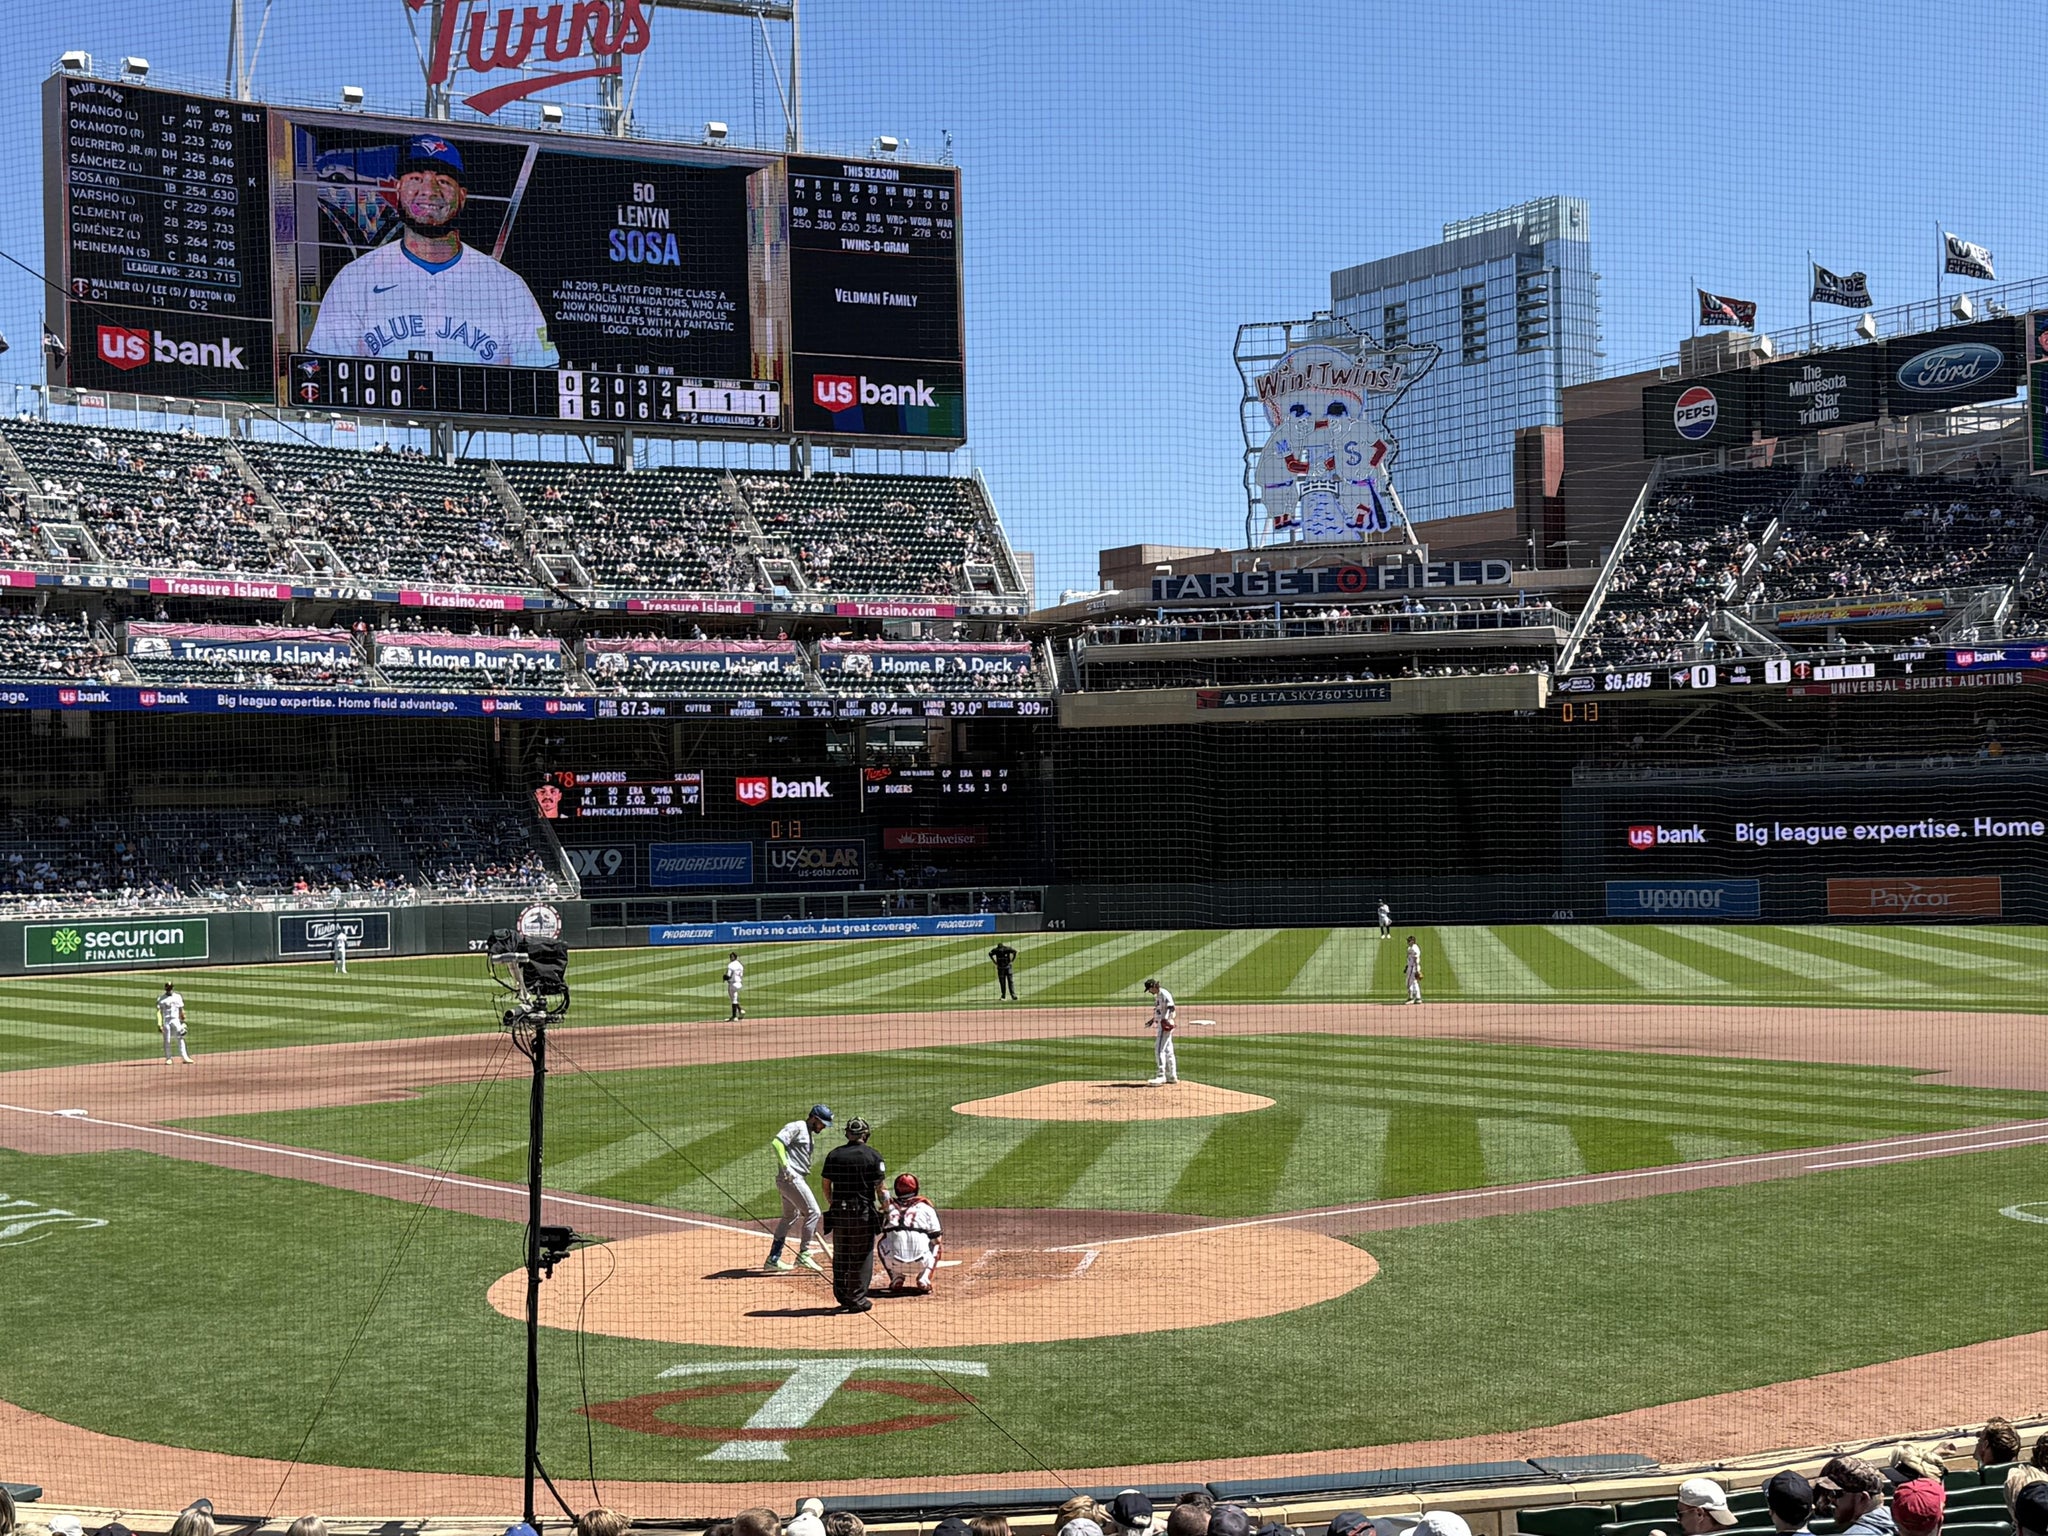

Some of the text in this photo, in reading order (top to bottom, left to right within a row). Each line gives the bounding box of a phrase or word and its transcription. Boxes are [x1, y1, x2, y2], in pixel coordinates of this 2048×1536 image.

[406, 0, 650, 85] Twins
[69, 83, 123, 103] BLUE JAYS
[70, 102, 232, 134] PINANGO LF .417 .878
[70, 119, 232, 150] OKAMOTO 3B .233 .769
[70, 136, 234, 167] GUERRERO JR. .325 .846
[71, 153, 233, 184] SÁNCHEZ .238 .675
[843, 165, 899, 181] THIS SEASON
[71, 171, 234, 201] SOSA .254 .630
[633, 182, 655, 202] 50
[72, 188, 119, 203] VARSHO
[73, 205, 127, 220] CLEMENT
[618, 205, 669, 228] LENYN
[73, 222, 124, 238] GIMÉNEZ
[815, 221, 884, 234] .380 .630 .254
[73, 240, 133, 256] HEINEMAN
[609, 229, 680, 266] SOSA
[841, 239, 909, 254] TWINS-O-GRAM
[91, 279, 221, 301] WALLNER LEE BUXTON
[562, 281, 572, 289] IN
[602, 284, 640, 294] PLAYED
[643, 286, 661, 295] FOR
[665, 288, 683, 297] THE
[686, 289, 717, 299] CLASS
[719, 292, 726, 300] A
[553, 290, 736, 311] KANNAPOLIS INTIMIDATORS, WHO ARE
[563, 302, 727, 320] NOW KNOWN AS THE KANNAPOLIS
[555, 312, 597, 322] CANNON
[600, 315, 645, 325] BALLERS
[647, 318, 671, 327] WITH
[684, 320, 734, 331] FANTASTIC
[364, 314, 498, 360] BLUE JAYS
[602, 325, 690, 338] LOGO. LOOK IT UP
[103, 331, 245, 370] us bank
[1802, 365, 1822, 381] The
[1917, 350, 1983, 386] Ford
[1255, 362, 1401, 401] Win! Twins!
[1789, 373, 1847, 397] Minnesota
[818, 376, 936, 407] us bank
[1815, 392, 1840, 408] Star
[1677, 403, 1715, 421] PEPSI
[1798, 407, 1839, 425] Tribune
[1151, 559, 1512, 599] TARGET FIELD
[165, 579, 278, 598] Treasure Island
[641, 601, 741, 614] Treasure Island
[182, 642, 334, 664] Treasure Island
[418, 651, 470, 668] Home
[1893, 652, 1925, 661] LAST PLAY
[1957, 650, 2007, 664] us bank
[881, 658, 1012, 672] Home Deck
[1831, 672, 2023, 695] UNIVERSAL SPORTS AUCTIONS
[60, 691, 75, 702] us
[77, 690, 111, 702] bank
[217, 694, 457, 712] Big league expertise. Home field advantage.
[1240, 692, 1286, 703] DELTA
[1348, 688, 1386, 699] SUITE
[621, 701, 650, 716] 87.3
[684, 704, 711, 713] CUTTER
[871, 702, 898, 715] 89.4
[1018, 702, 1040, 715] 309
[555, 771, 626, 788] 78 MORRIS
[739, 777, 831, 798] us bank
[885, 785, 912, 793] ROGERS
[581, 797, 596, 805] 14.1
[626, 796, 645, 805] 5.02
[914, 832, 975, 845] Budweiser
[1630, 824, 1705, 844] us bank
[1735, 817, 2045, 846] Big league expertise. Home
[568, 849, 622, 875] OX 9
[656, 857, 746, 871] PROGRESSIVE
[798, 867, 858, 877] us-solar.com
[1639, 890, 1723, 912] uponor
[1871, 888, 1950, 910] Paycor
[1048, 920, 1066, 928] 411
[1552, 910, 1574, 920] 403
[85, 928, 183, 947] securian
[343, 925, 358, 934] TV
[662, 920, 984, 938] PROGRESSIVE There's no catch. Just great coverage. PROGRESSIVE
[85, 948, 155, 960] FINANCIAL
